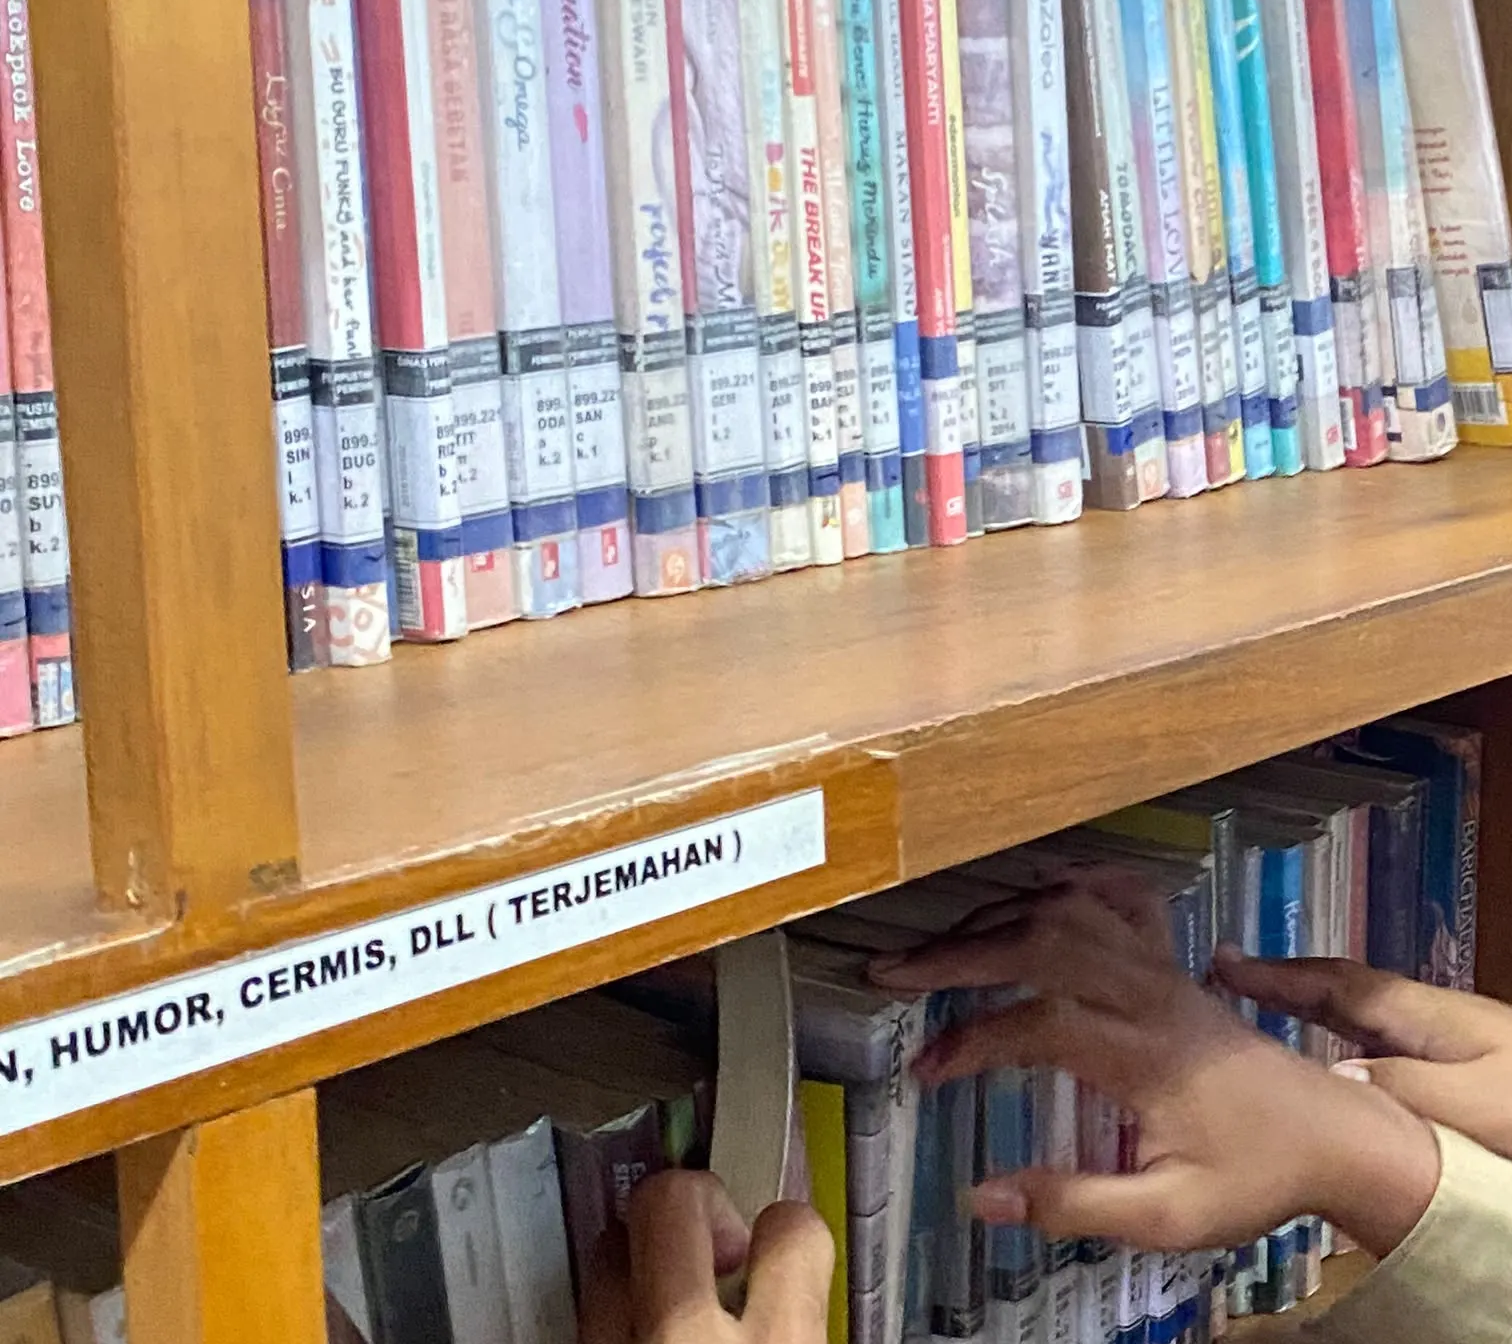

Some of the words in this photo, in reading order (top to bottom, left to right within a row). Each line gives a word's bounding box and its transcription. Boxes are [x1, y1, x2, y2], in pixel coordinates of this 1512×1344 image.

[505, 52, 534, 153] Omega
[332, 100, 348, 153] GURU
[16, 139, 38, 212] Love
[798, 145, 816, 196] THE
[894, 130, 911, 224] MAKAN
[803, 200, 827, 284] BREAK
[538, 414, 566, 430] ODA
[575, 409, 603, 424] SAN
[286, 449, 310, 464] SIN
[343, 455, 376, 471] BUG
[439, 464, 447, 478] b
[344, 476, 353, 490] b
[30, 519, 41, 533] b
[49, 992, 225, 1069] HUMOR,
[239, 938, 397, 1009] CERMIS,
[410, 913, 475, 956] DLL
[508, 833, 724, 925] TERJEMAHAN
